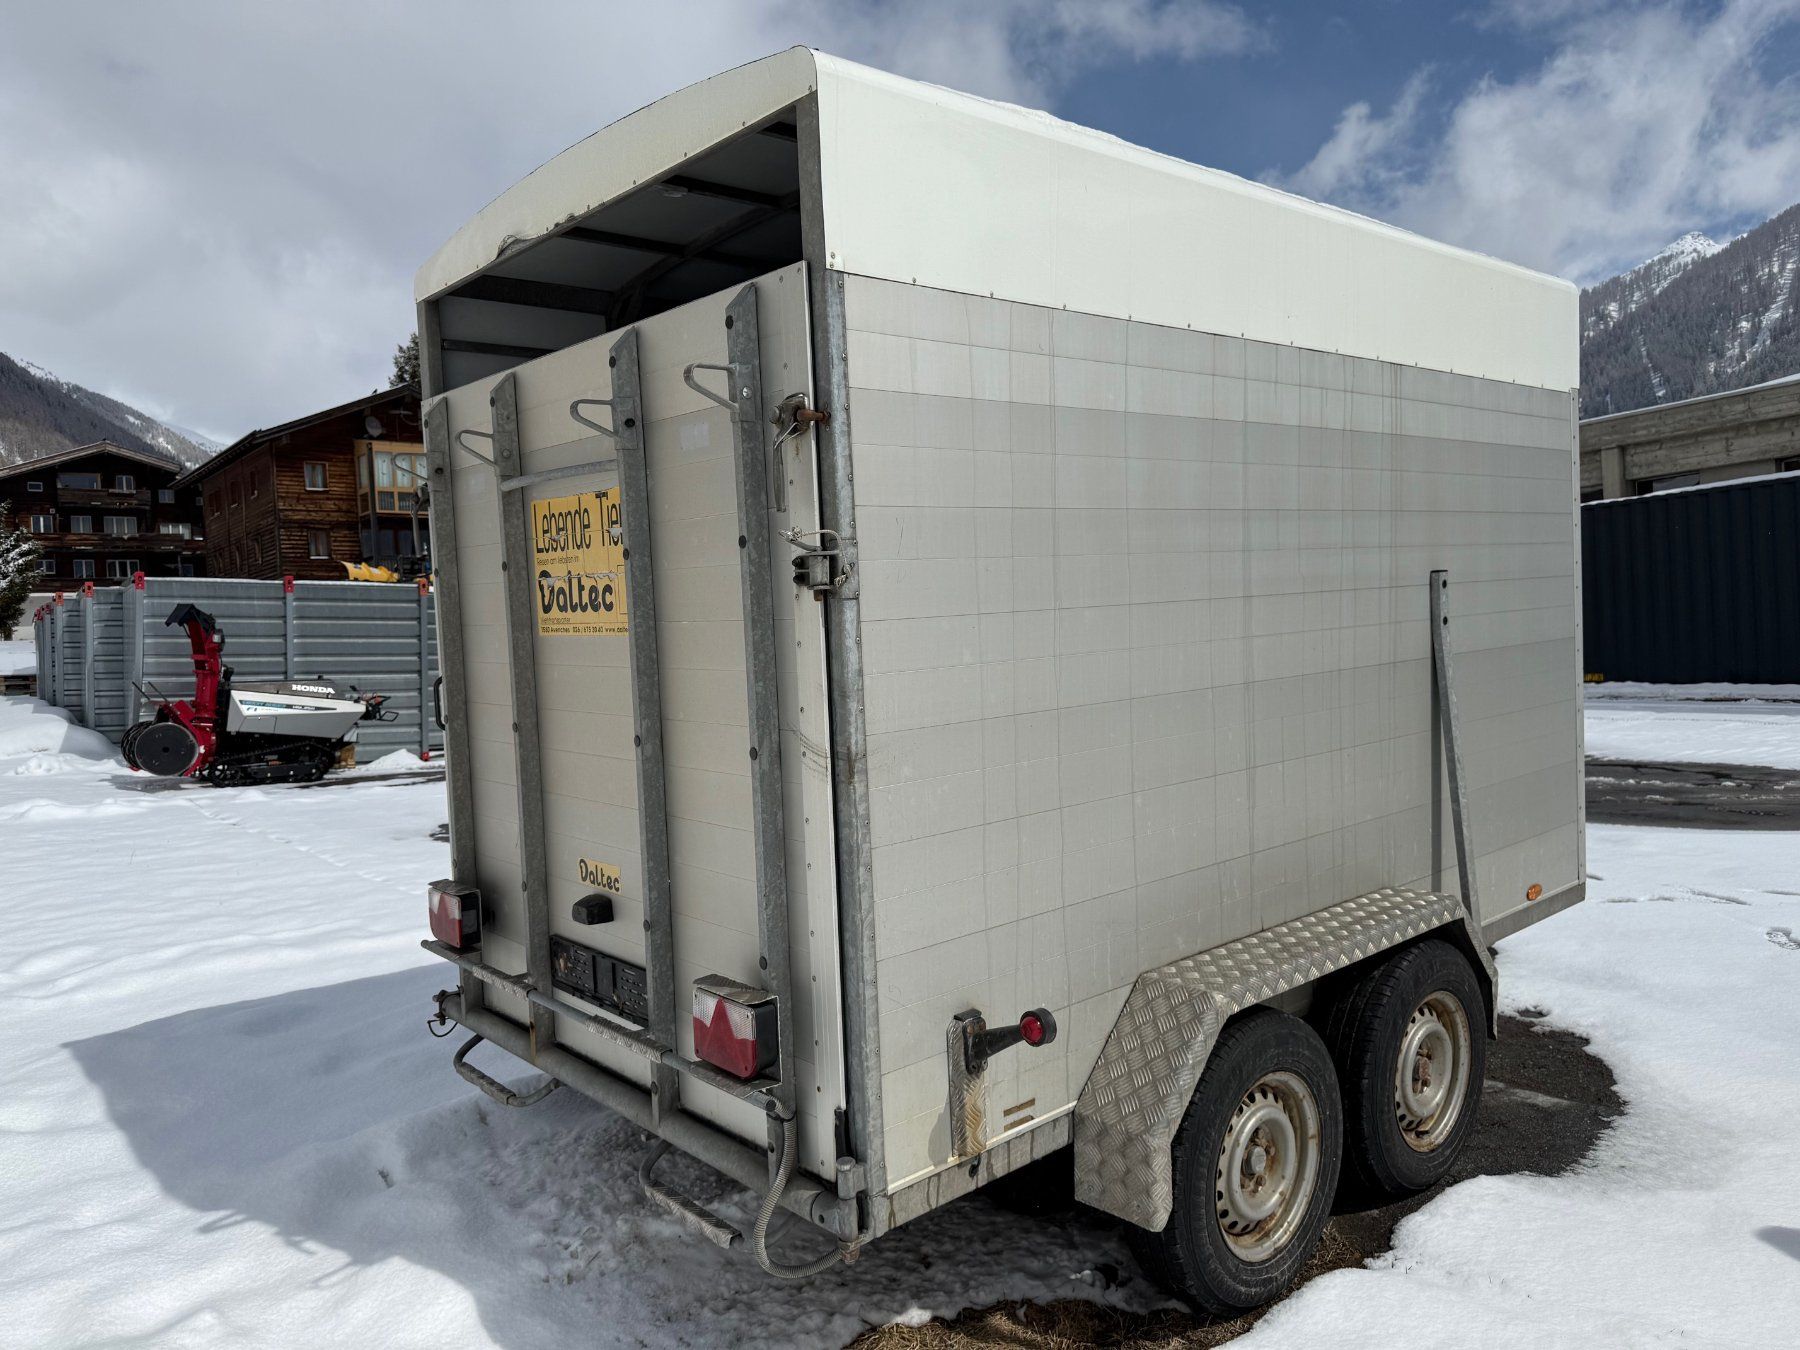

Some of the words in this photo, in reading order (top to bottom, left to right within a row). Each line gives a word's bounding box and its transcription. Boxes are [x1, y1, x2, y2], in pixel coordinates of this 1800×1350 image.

[533, 496, 592, 553] Lebende
[538, 569, 614, 614] Daltec
[291, 684, 336, 694] HONDA
[579, 858, 620, 892] Daltec
